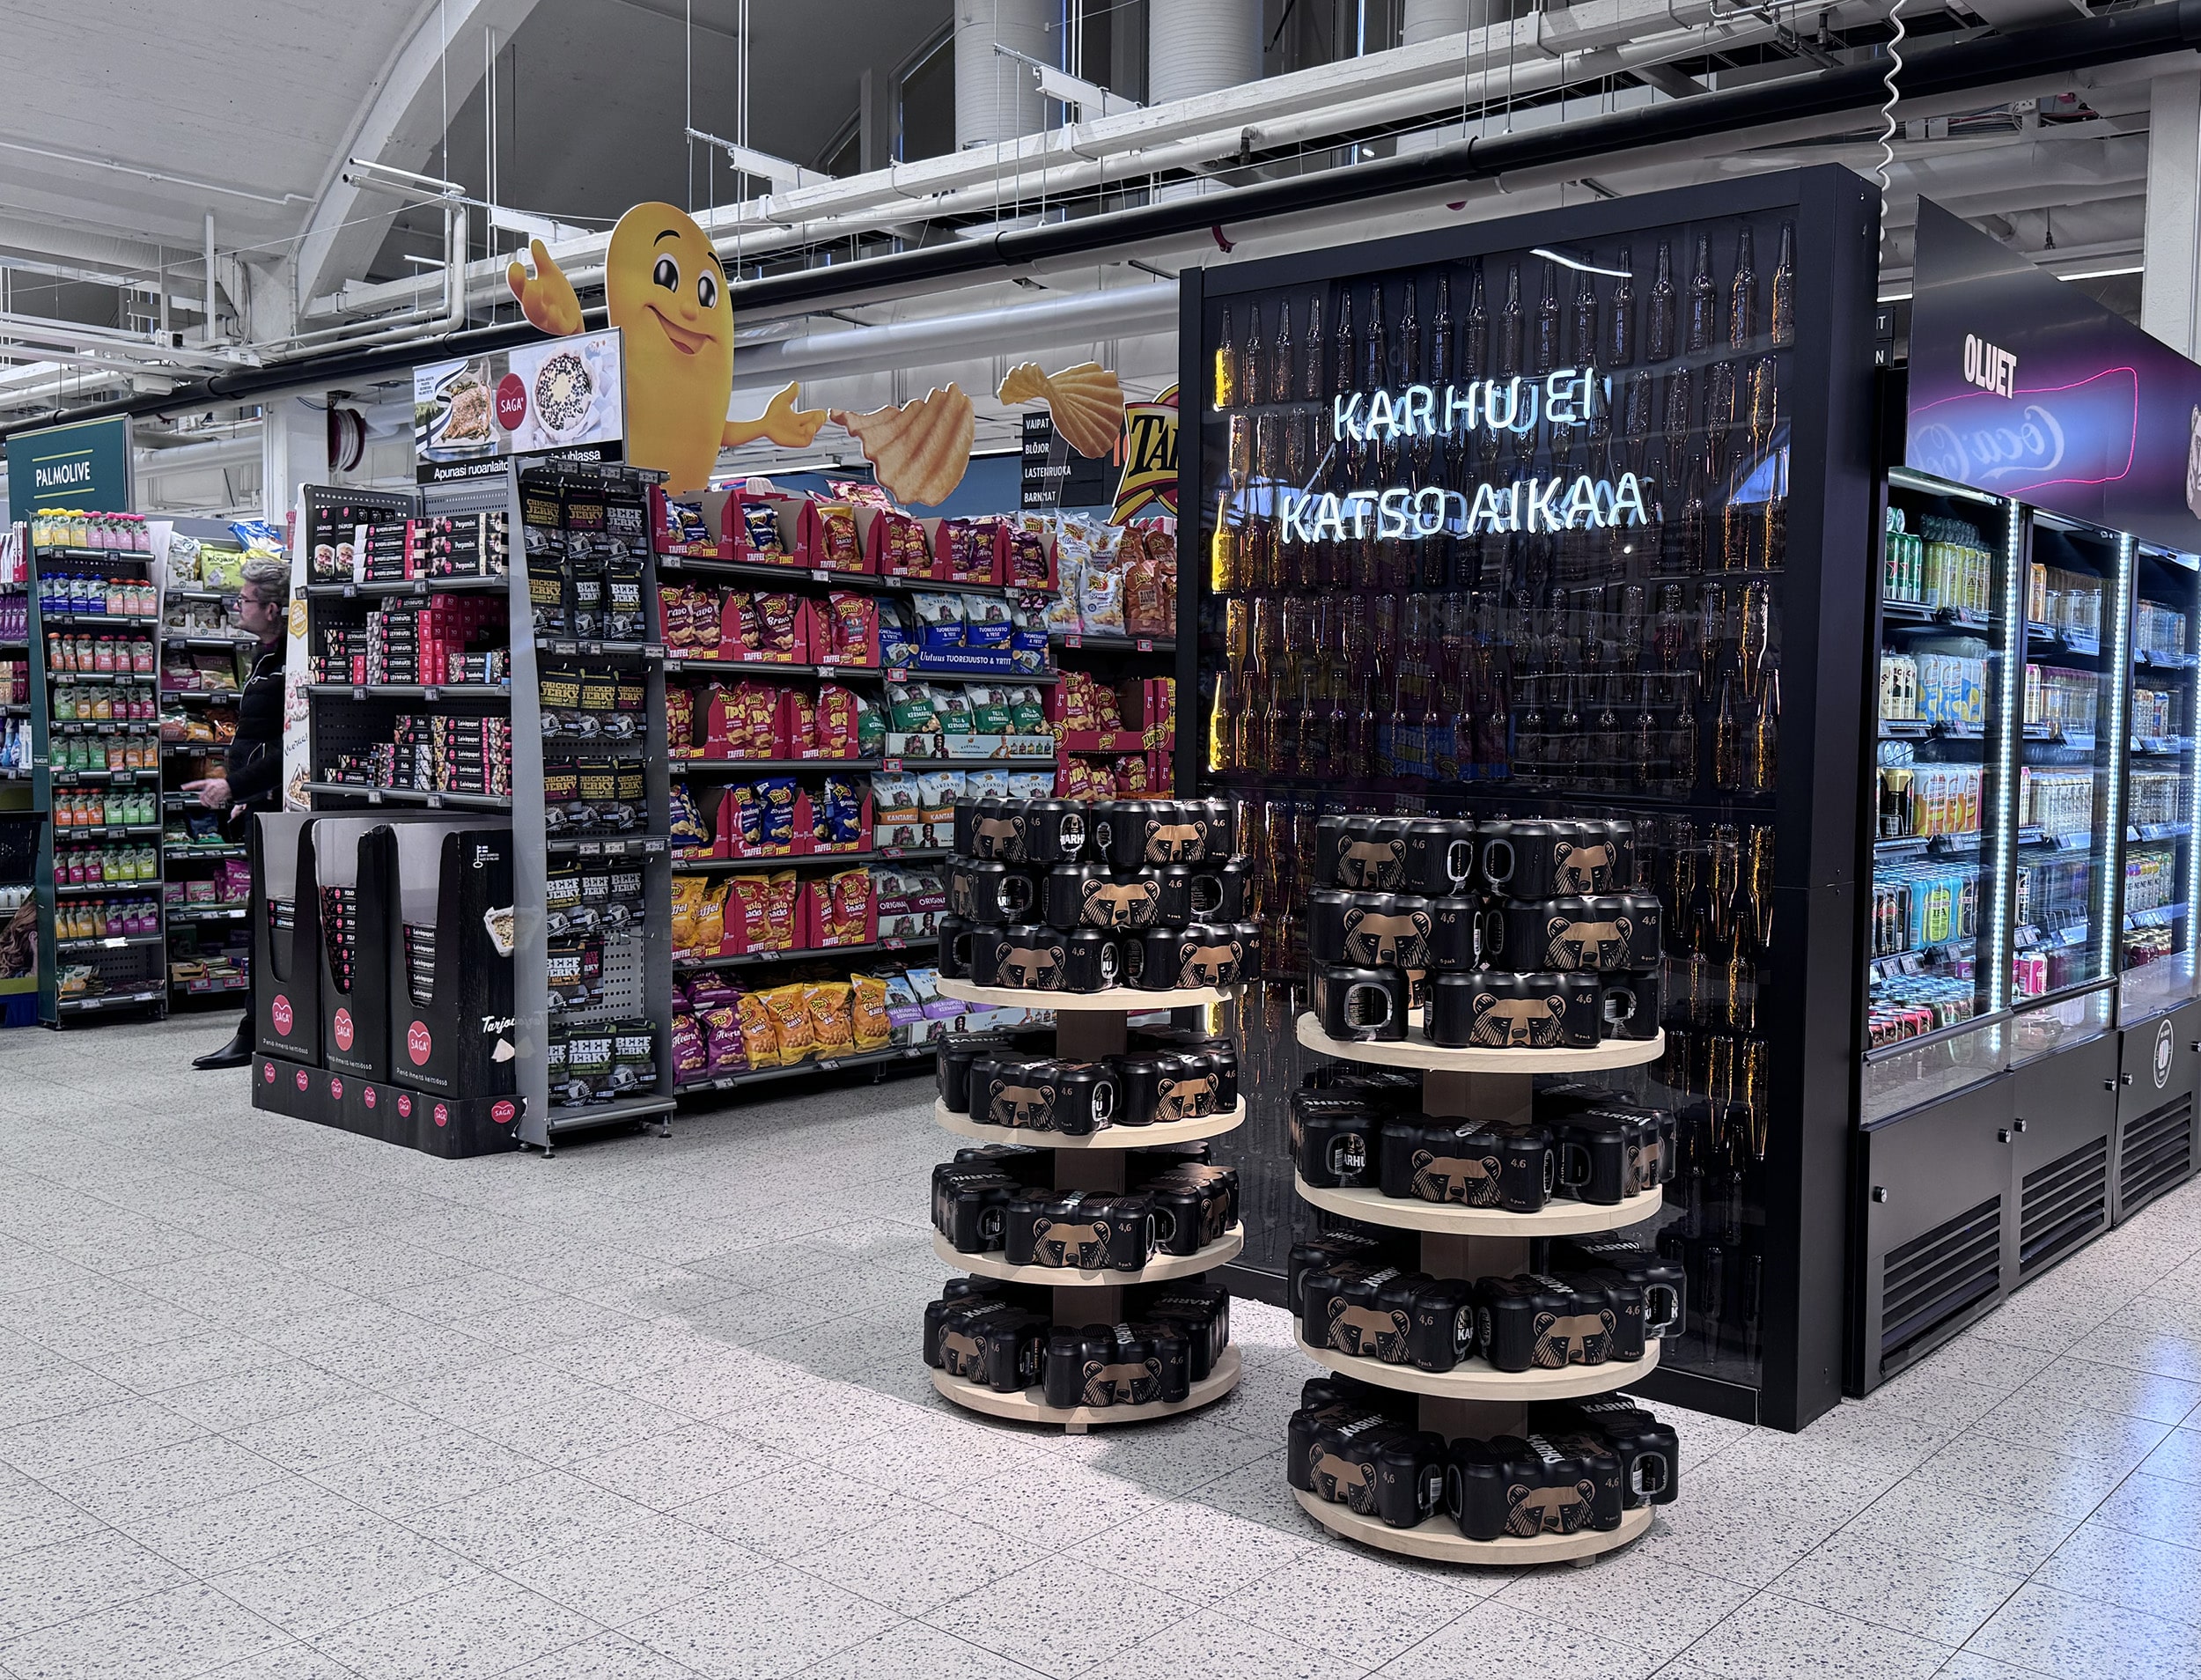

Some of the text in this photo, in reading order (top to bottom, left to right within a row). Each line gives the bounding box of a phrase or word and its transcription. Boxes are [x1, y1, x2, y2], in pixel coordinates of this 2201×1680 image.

[1964, 333, 2017, 399] OLUET
[501, 399, 522, 413] SAGA
[1334, 367, 1593, 441] KARHU EI
[1026, 417, 1049, 430] VAIPAT
[1025, 442, 1049, 454] BLÖJOR
[36, 461, 90, 487] PALMOLIVE
[434, 466, 467, 479] Apunasi
[1025, 466, 1071, 478] LASTENRUOKA
[1025, 491, 1056, 503] BARNMAT
[526, 498, 559, 508] CHICKEN
[1282, 472, 1646, 544] KATSO AIKAA
[526, 506, 559, 516] JERKY
[570, 510, 603, 519] JERKY
[607, 507, 642, 519] BEEF
[607, 518, 643, 527] JERKY
[669, 545, 688, 554] TAFFEL
[611, 584, 639, 594] BEEF
[612, 593, 640, 602] JERKY
[670, 649, 688, 658] TAFFEL
[744, 652, 762, 660] TAFFEL
[920, 652, 945, 662] Uutuus
[946, 655, 988, 664] TUOREJUUSTO
[541, 682, 579, 690] CHICKEN
[541, 688, 578, 699] JERKY
[803, 749, 819, 758] TAFFEL
[1030, 818, 1041, 827] 4,6
[1212, 818, 1226, 828] 4,6
[814, 844, 831, 852] TAFFEL
[1411, 839, 1425, 850] 4,6
[743, 847, 762, 857] TAFFEL
[547, 878, 579, 890] BEEF
[582, 876, 609, 888] BEEF
[611, 873, 641, 885] BEEF
[582, 886, 609, 896] JERKY
[611, 882, 641, 893] JERKY
[547, 888, 580, 900] JERKY
[1440, 912, 1456, 924] 4,6
[1642, 915, 1656, 925] 4,6
[747, 942, 764, 953] TAFFEL
[822, 937, 838, 947] TAFFEL
[1249, 939, 1260, 949] 4,6
[1071, 947, 1086, 956] 4,6
[1576, 994, 1593, 1004] 4,6
[276, 1012, 289, 1022] SAGA
[337, 1026, 350, 1037] SAGA
[411, 1041, 427, 1051] SAGA
[615, 1036, 651, 1047] BEEF
[616, 1044, 651, 1055] JERKY
[1225, 1070, 1235, 1079] 4,6
[1061, 1087, 1072, 1096] 4,6
[1343, 1153, 1366, 1167] ARHU
[1511, 1158, 1526, 1168] 4,6
[1118, 1223, 1132, 1233] 4,6
[1625, 1305, 1641, 1316] 4,6
[1418, 1315, 1433, 1326] 4,6
[1337, 1413, 1385, 1437] KARHU
[1527, 1434, 1564, 1463] KARHU
[1382, 1471, 1396, 1485] 4,6
[1605, 1477, 1620, 1488] 4,6
